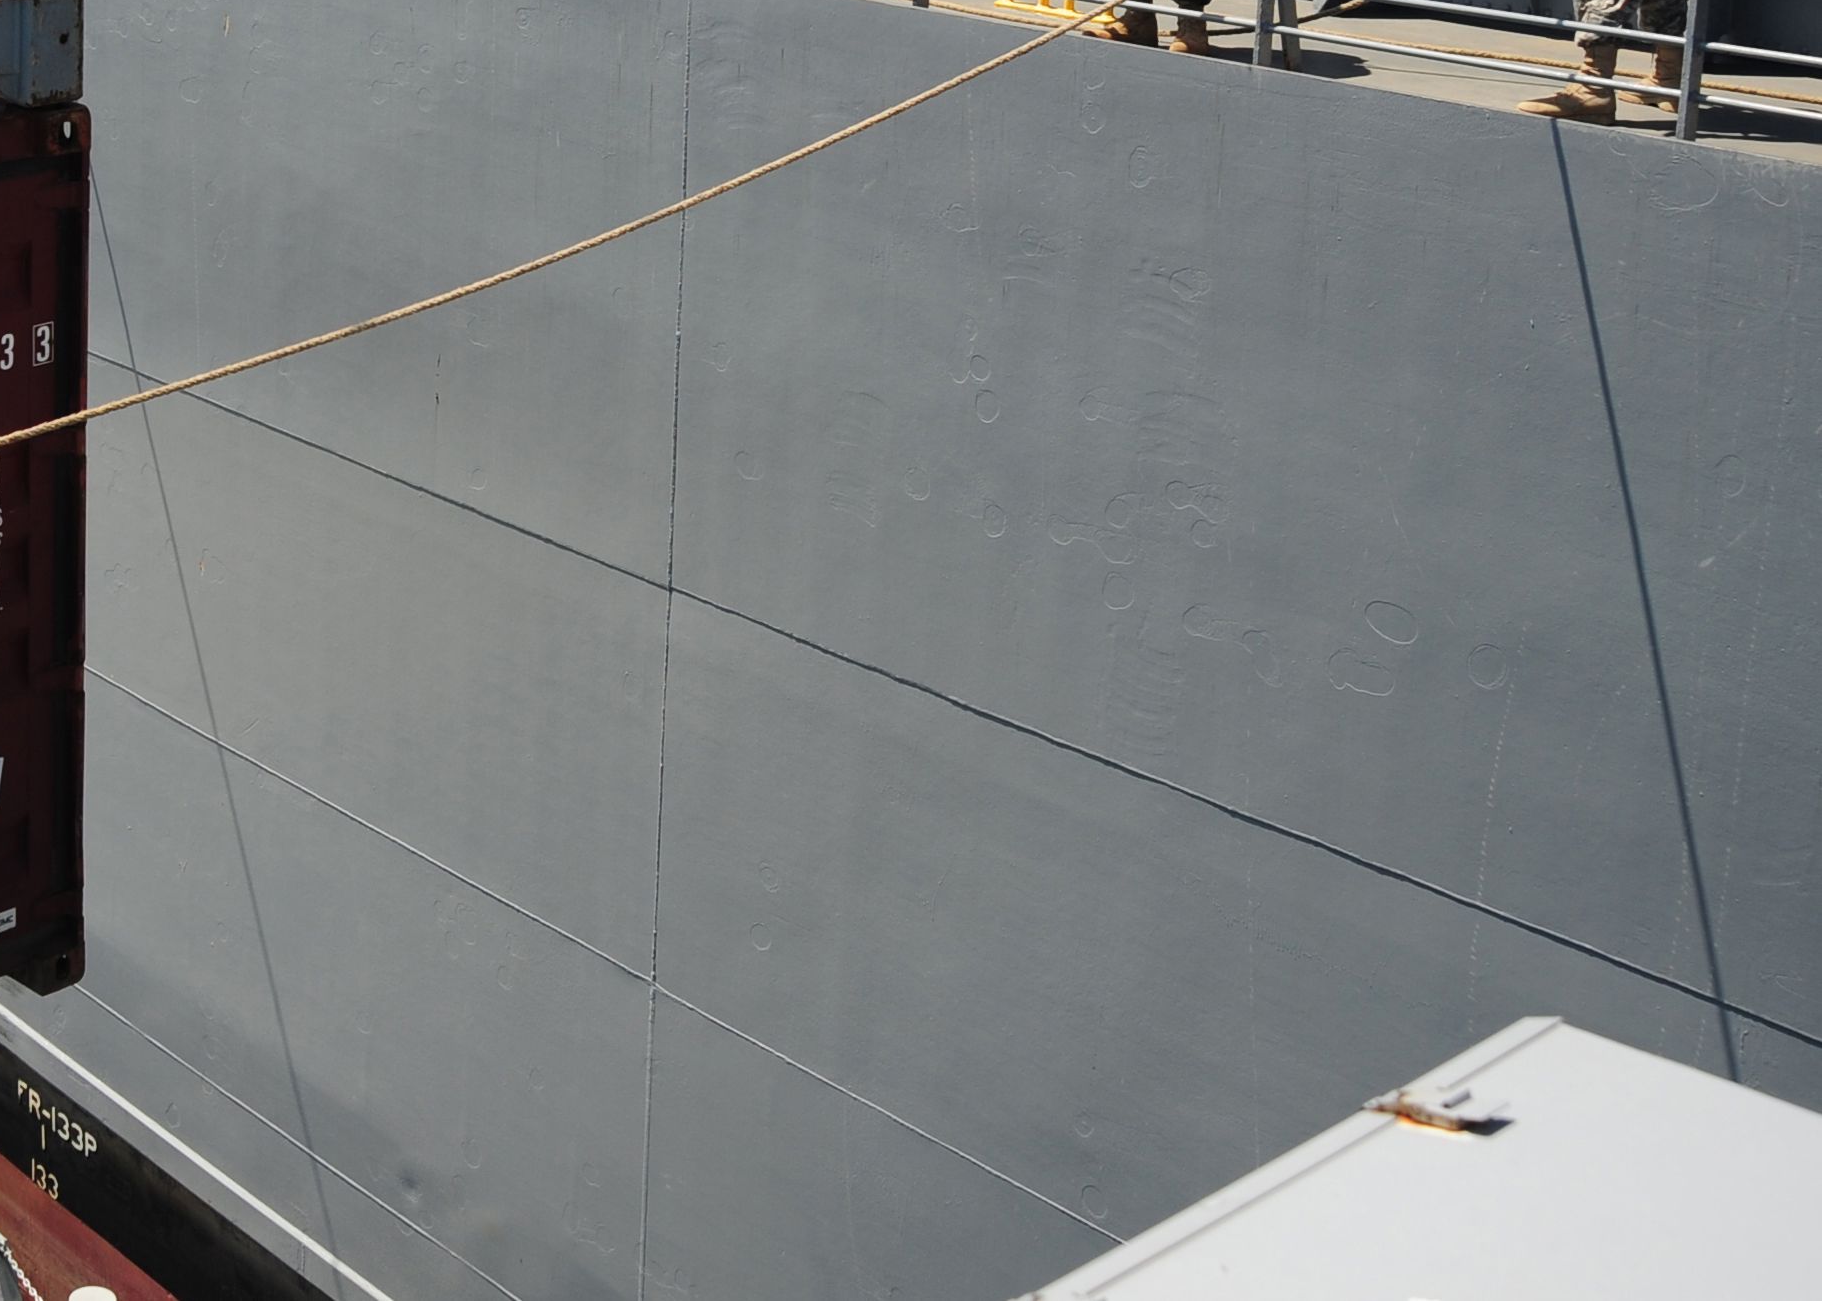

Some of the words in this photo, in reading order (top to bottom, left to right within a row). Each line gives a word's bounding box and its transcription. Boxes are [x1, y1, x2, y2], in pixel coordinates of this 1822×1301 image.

[35, 323, 52, 365] 3
[18, 1079, 98, 1157] FR-133P
[31, 1158, 59, 1201] 133
